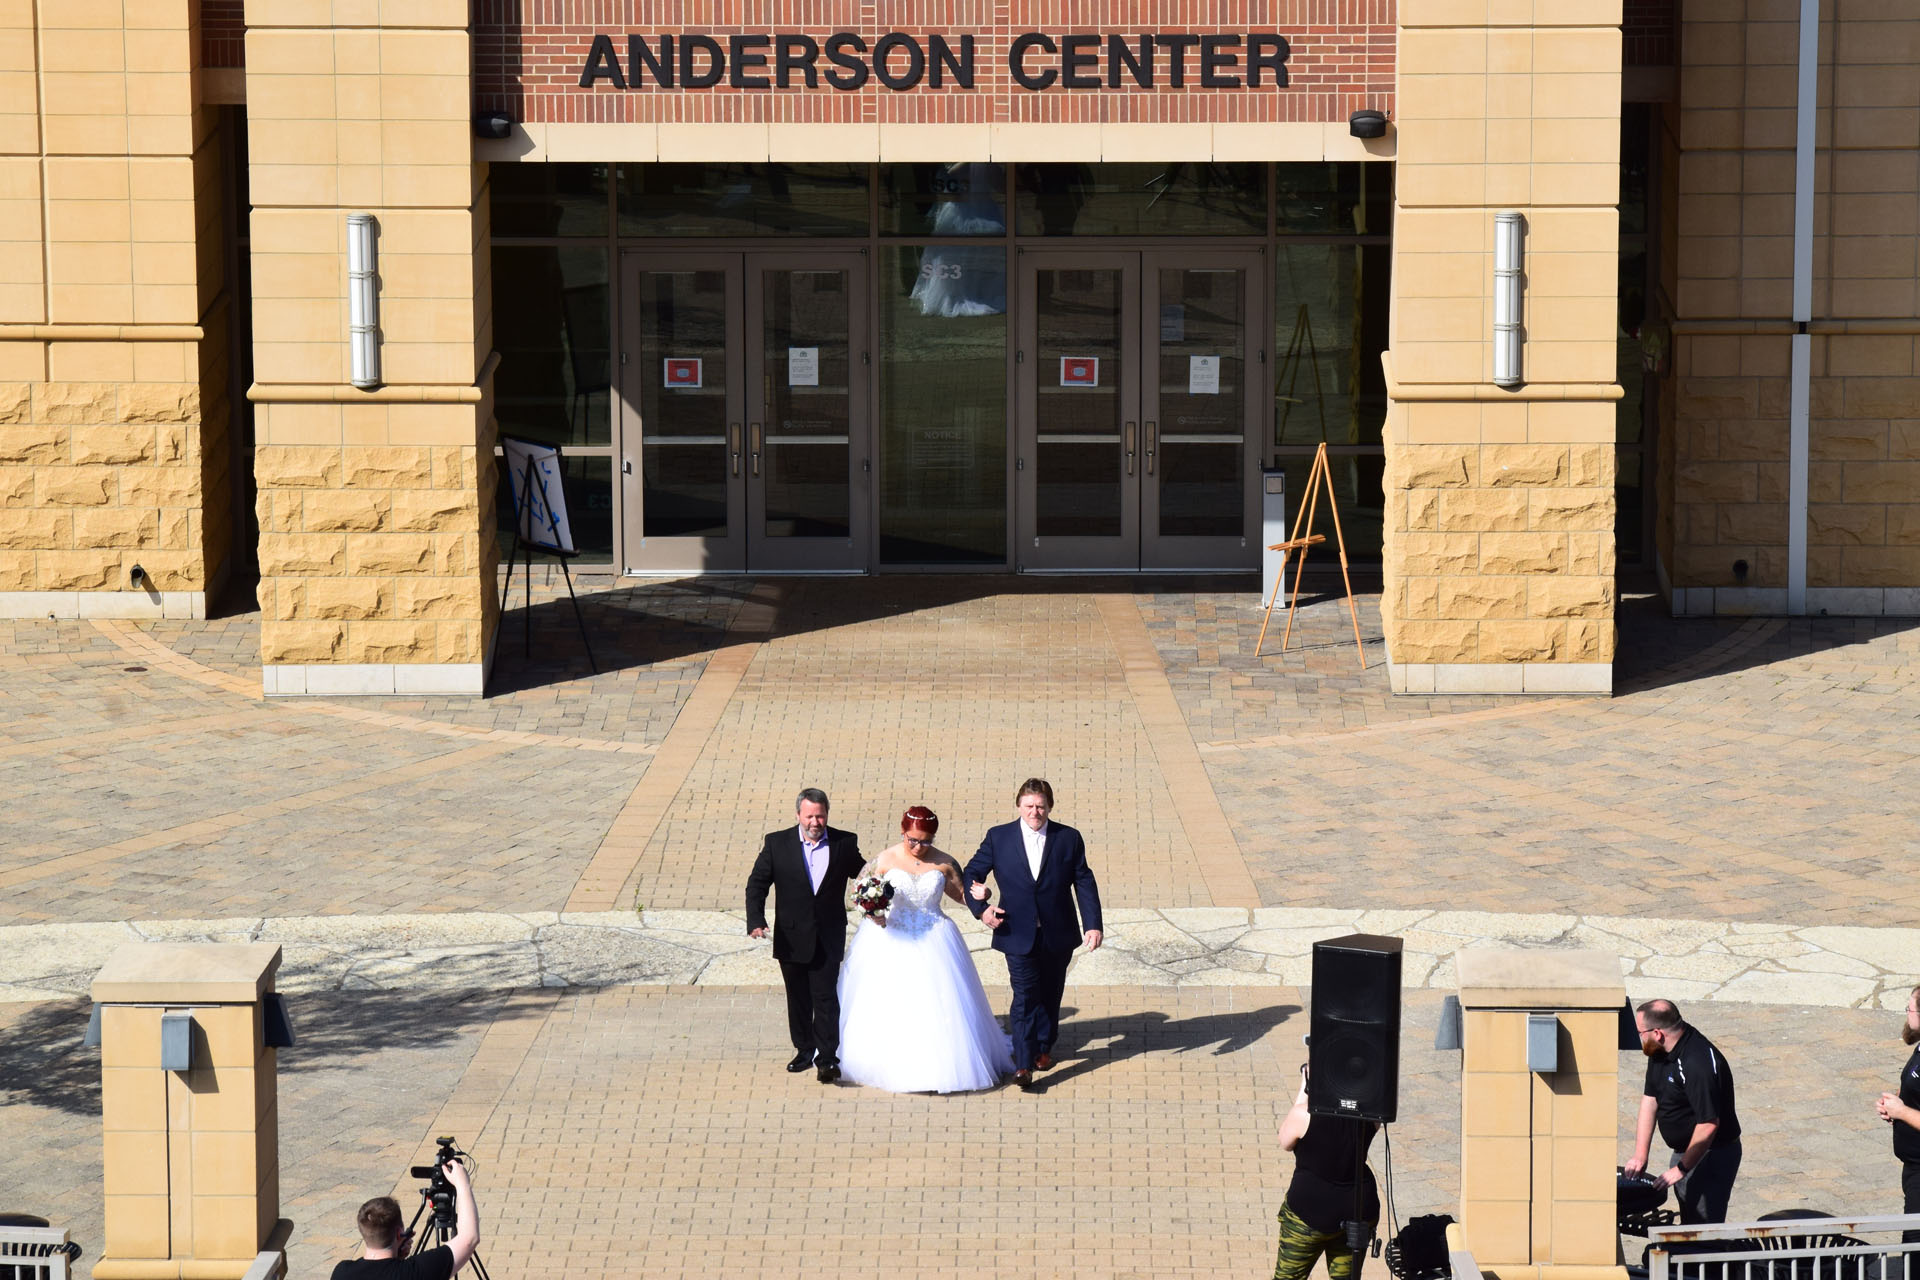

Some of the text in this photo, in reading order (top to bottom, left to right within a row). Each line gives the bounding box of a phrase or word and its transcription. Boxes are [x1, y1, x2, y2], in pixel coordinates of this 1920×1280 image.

[579, 32, 1292, 91] ANDERSON CENTER
[921, 263, 962, 279] SC3
